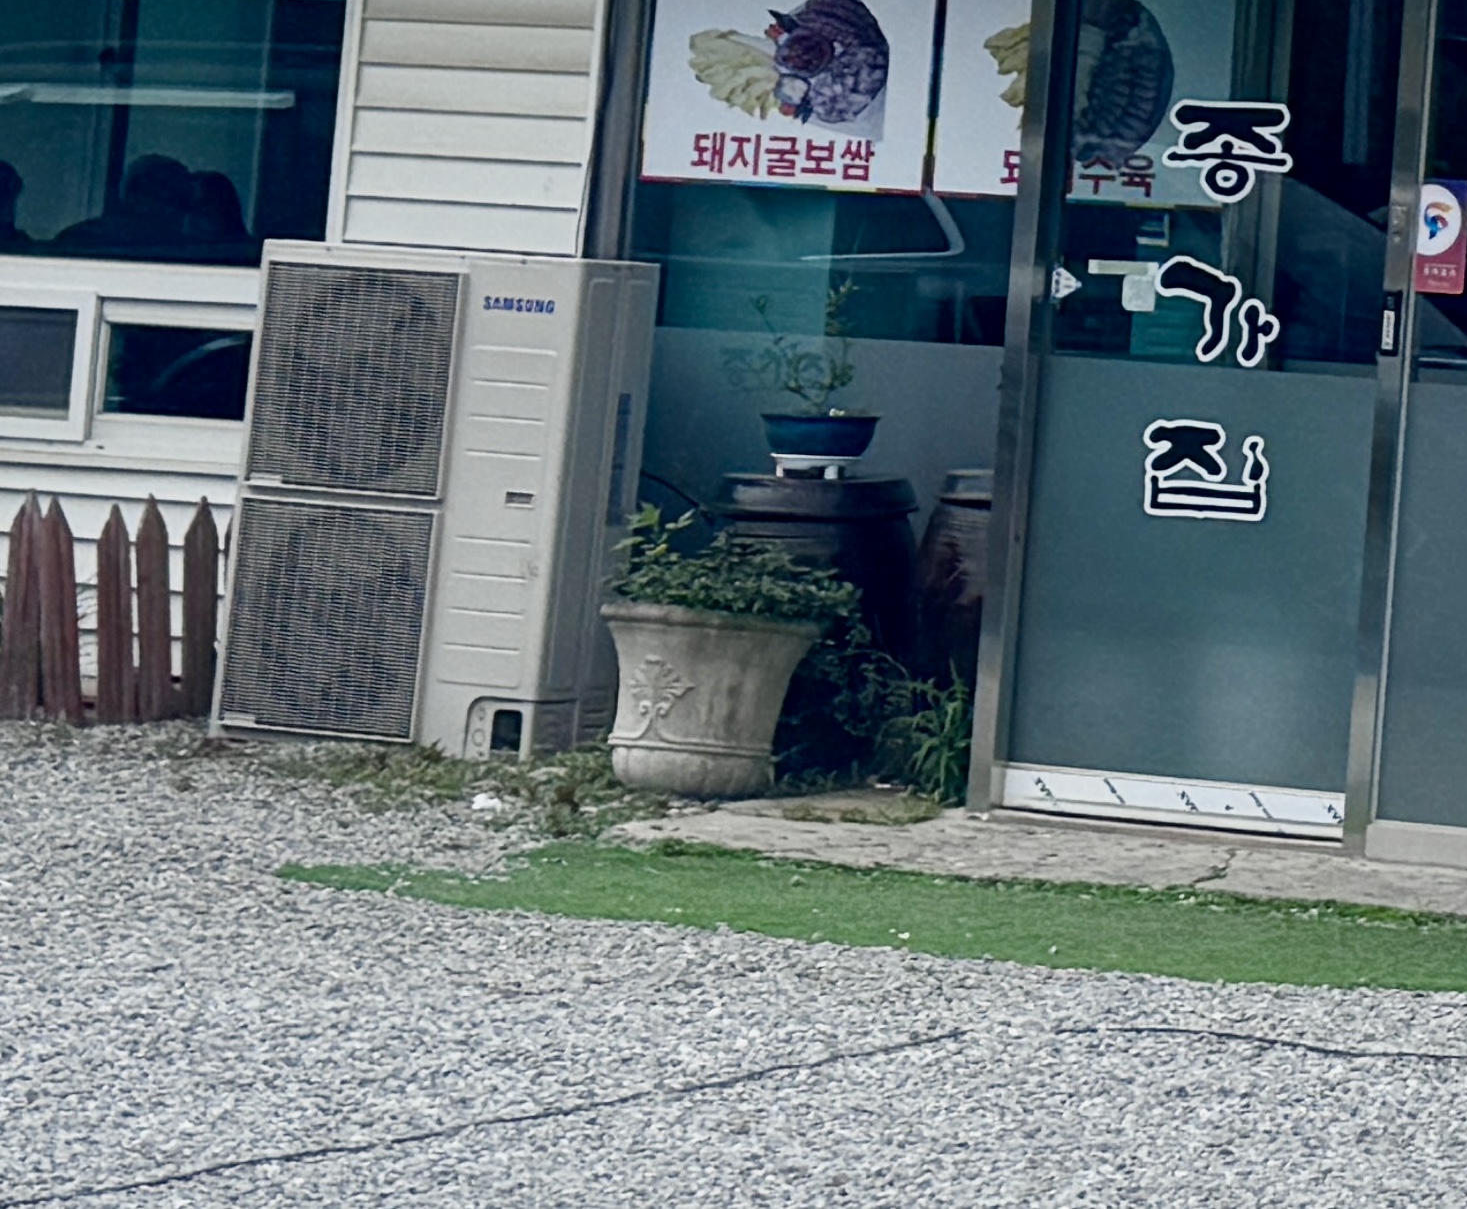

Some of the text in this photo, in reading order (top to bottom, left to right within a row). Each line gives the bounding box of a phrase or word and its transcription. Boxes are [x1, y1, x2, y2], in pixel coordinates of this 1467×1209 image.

[690, 131, 876, 182] 돼지굴보쌈
[483, 295, 555, 314] SAMSUNG
[1143, 99, 1292, 521] 종가집
